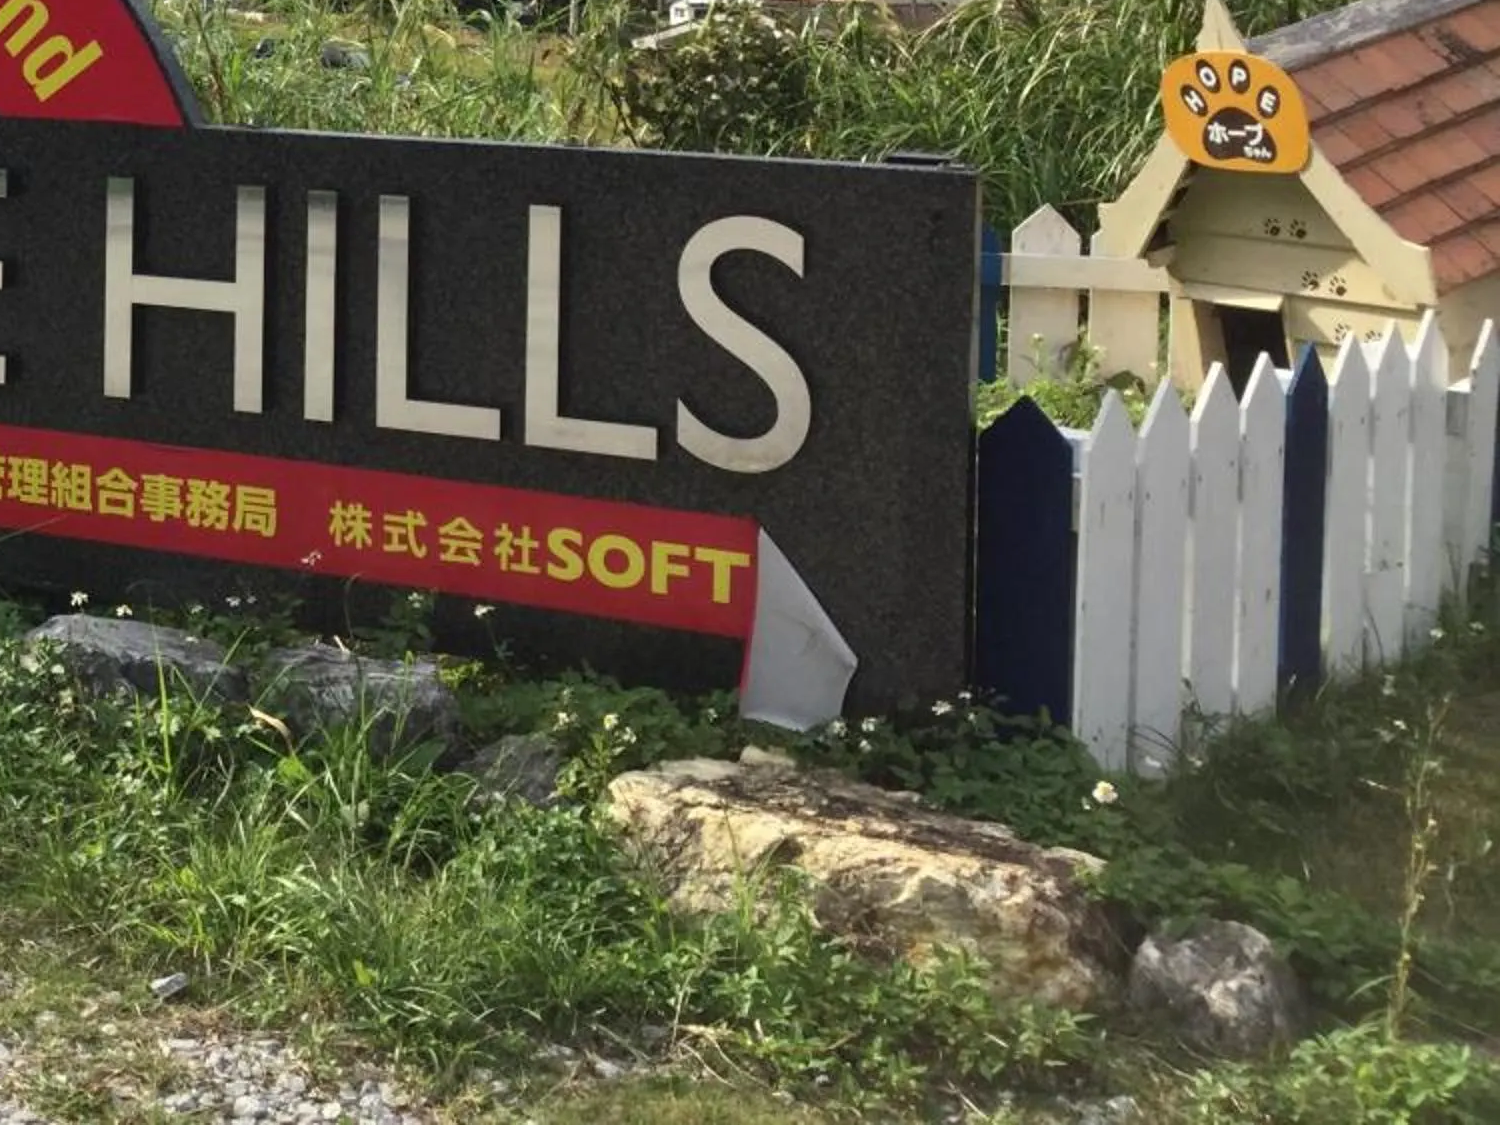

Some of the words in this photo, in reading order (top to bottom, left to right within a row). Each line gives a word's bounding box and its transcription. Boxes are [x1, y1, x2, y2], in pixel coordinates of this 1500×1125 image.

[1207, 121, 1264, 146] ホープ
[103, 176, 812, 473] HILLS
[329, 500, 750, 604] 株式会社SOFT
